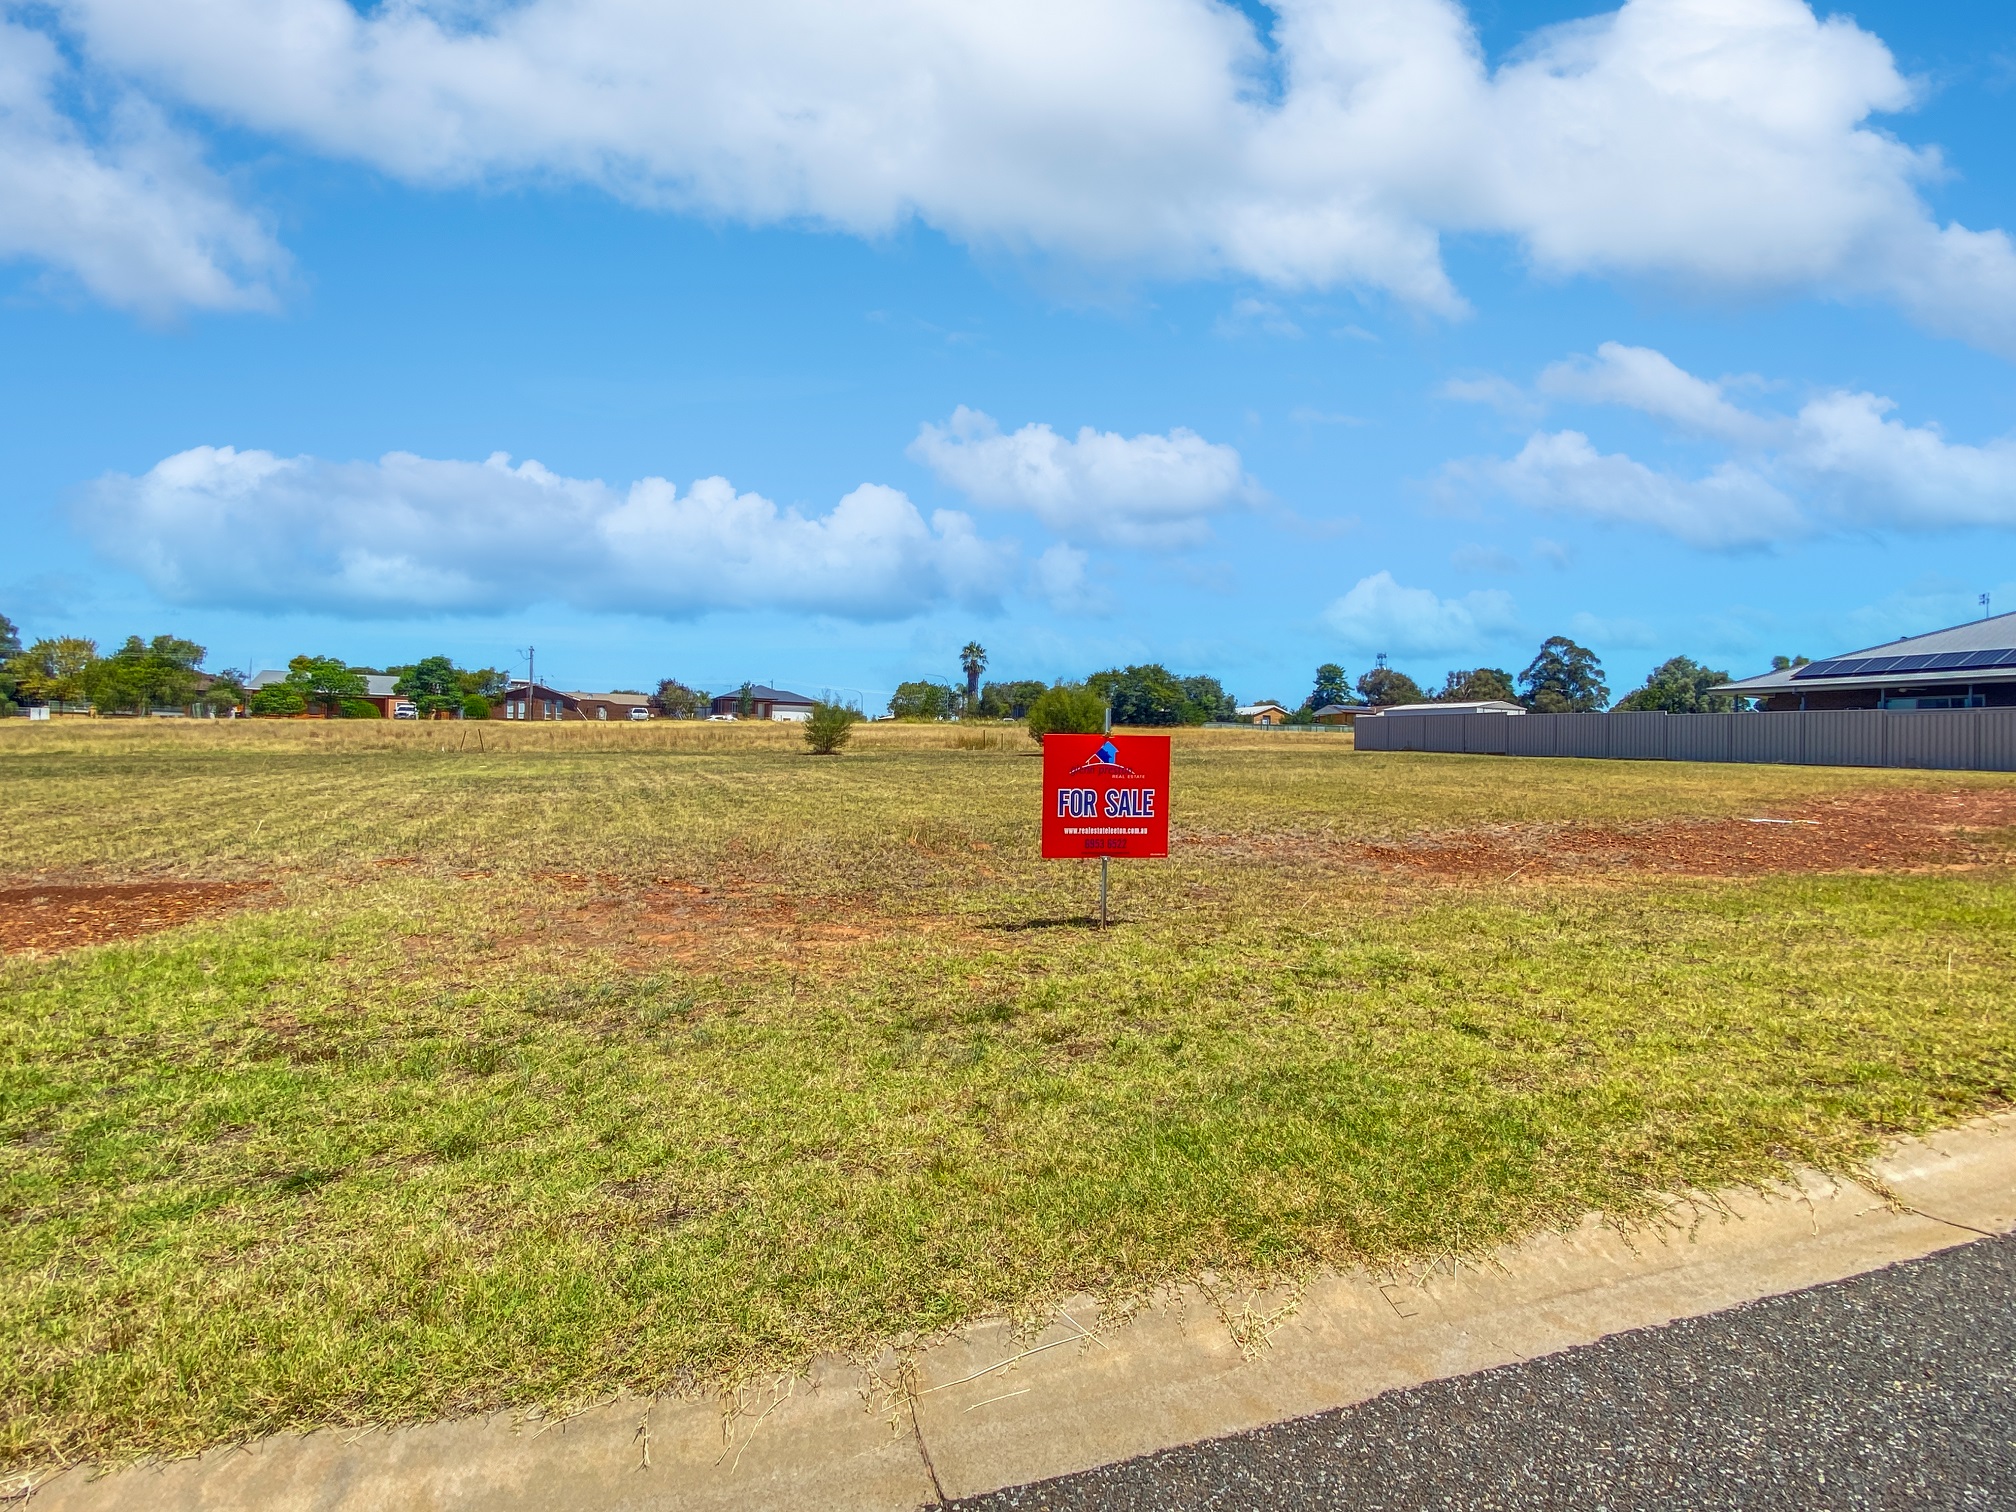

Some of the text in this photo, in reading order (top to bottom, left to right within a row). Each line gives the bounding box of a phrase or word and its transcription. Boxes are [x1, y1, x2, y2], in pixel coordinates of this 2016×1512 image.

[1057, 788, 1155, 817] FOR SALE
[1064, 826, 1148, 835] www.realestateleeton.com.au
